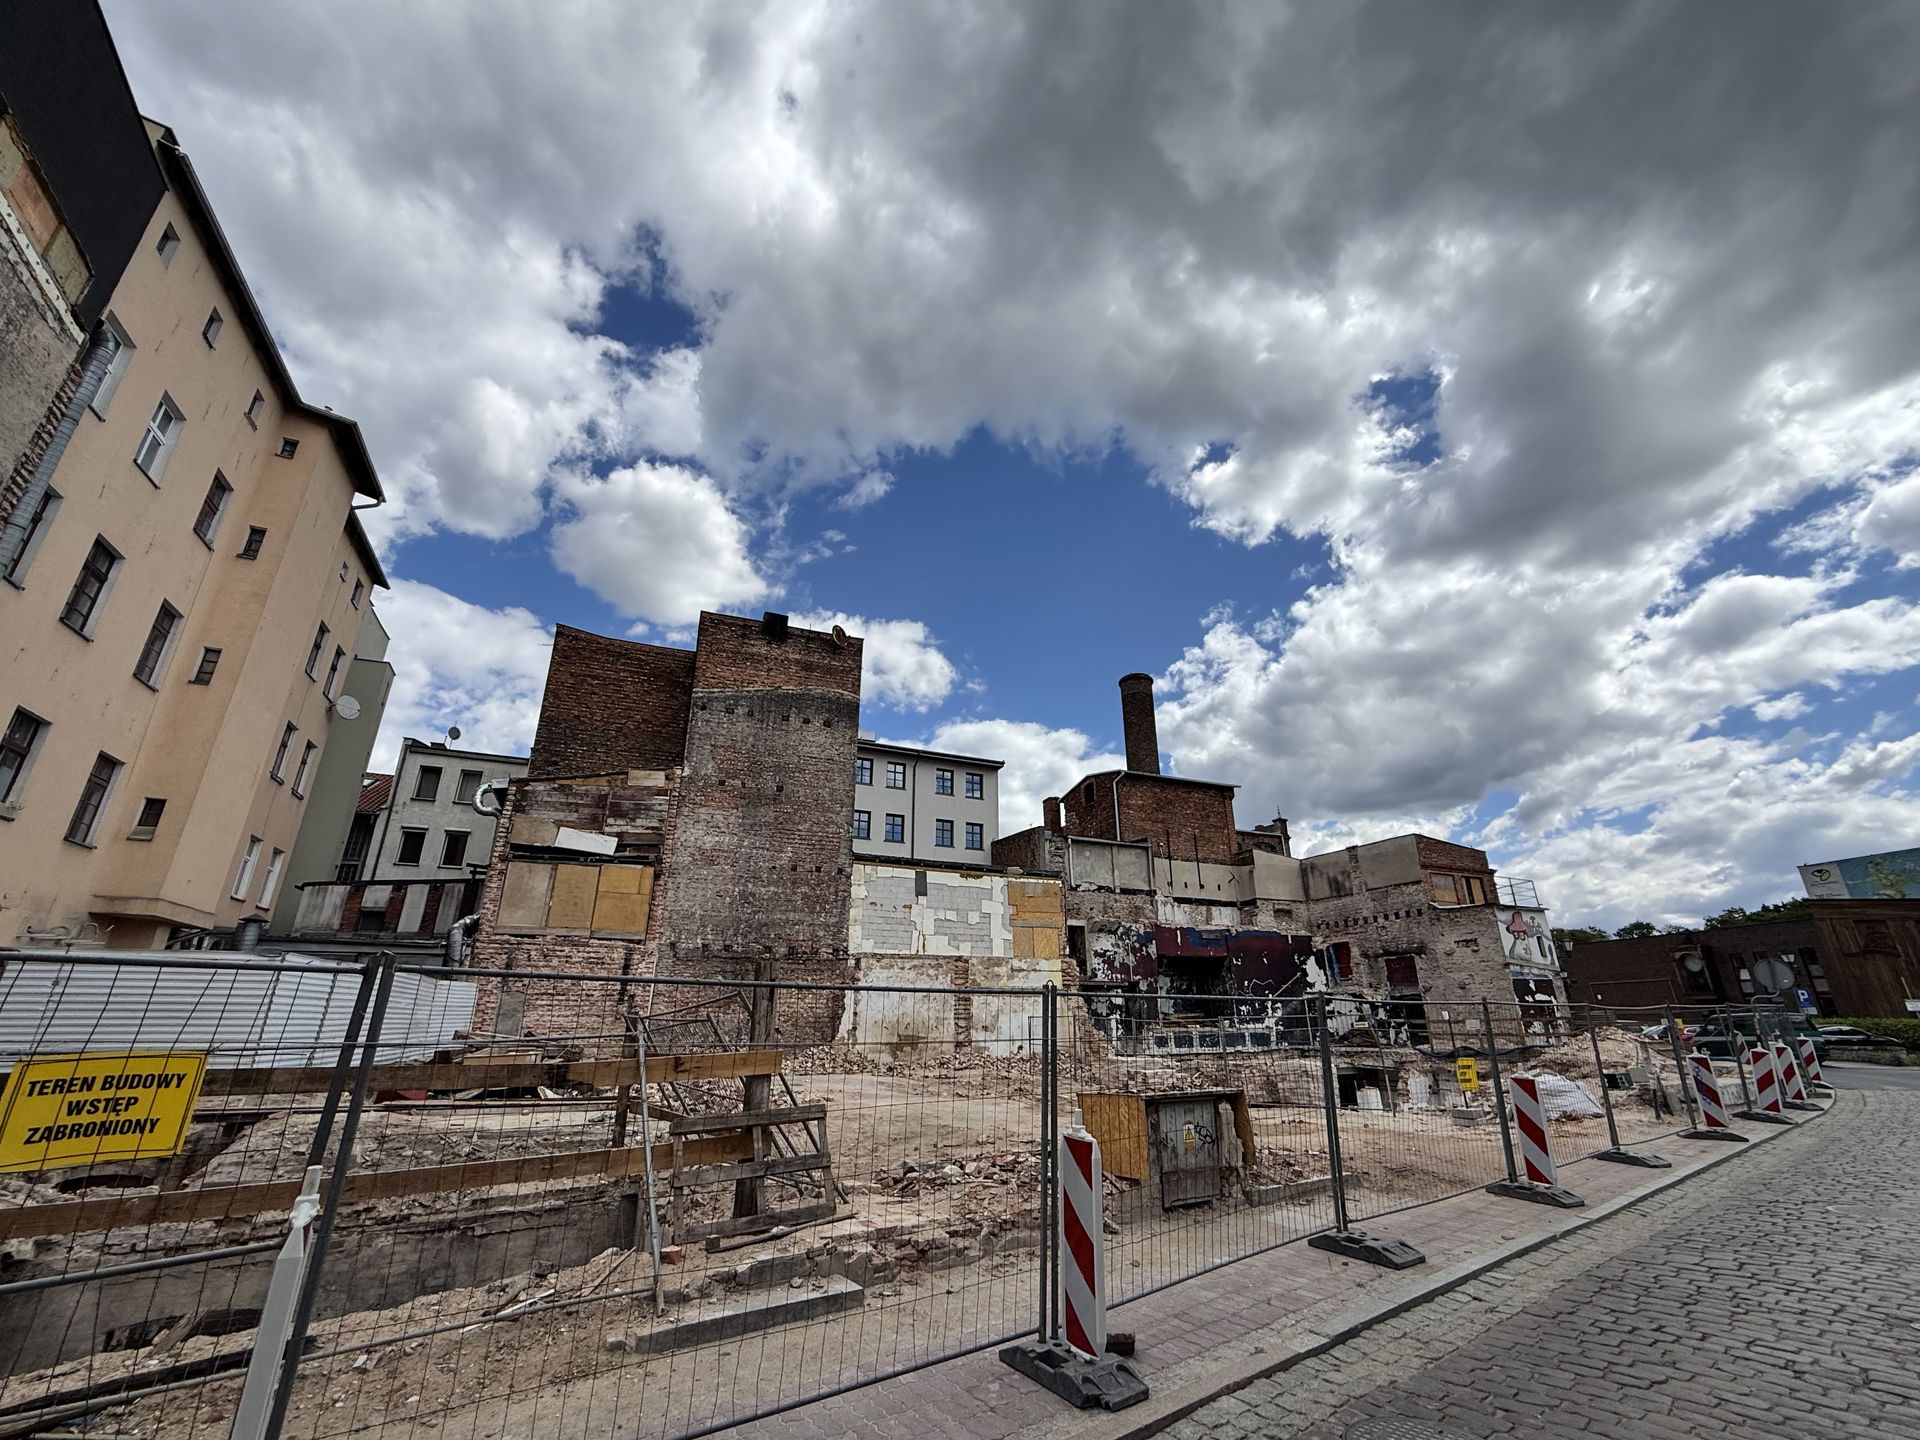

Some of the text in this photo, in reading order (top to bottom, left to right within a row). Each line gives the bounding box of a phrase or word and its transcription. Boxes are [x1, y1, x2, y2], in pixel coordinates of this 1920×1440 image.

[1797, 989, 1809, 1002] P
[27, 1073, 187, 1097] TEREN BUDOWY
[66, 1096, 139, 1116] WSTĘP
[23, 1117, 161, 1145] ZABRONIONY
